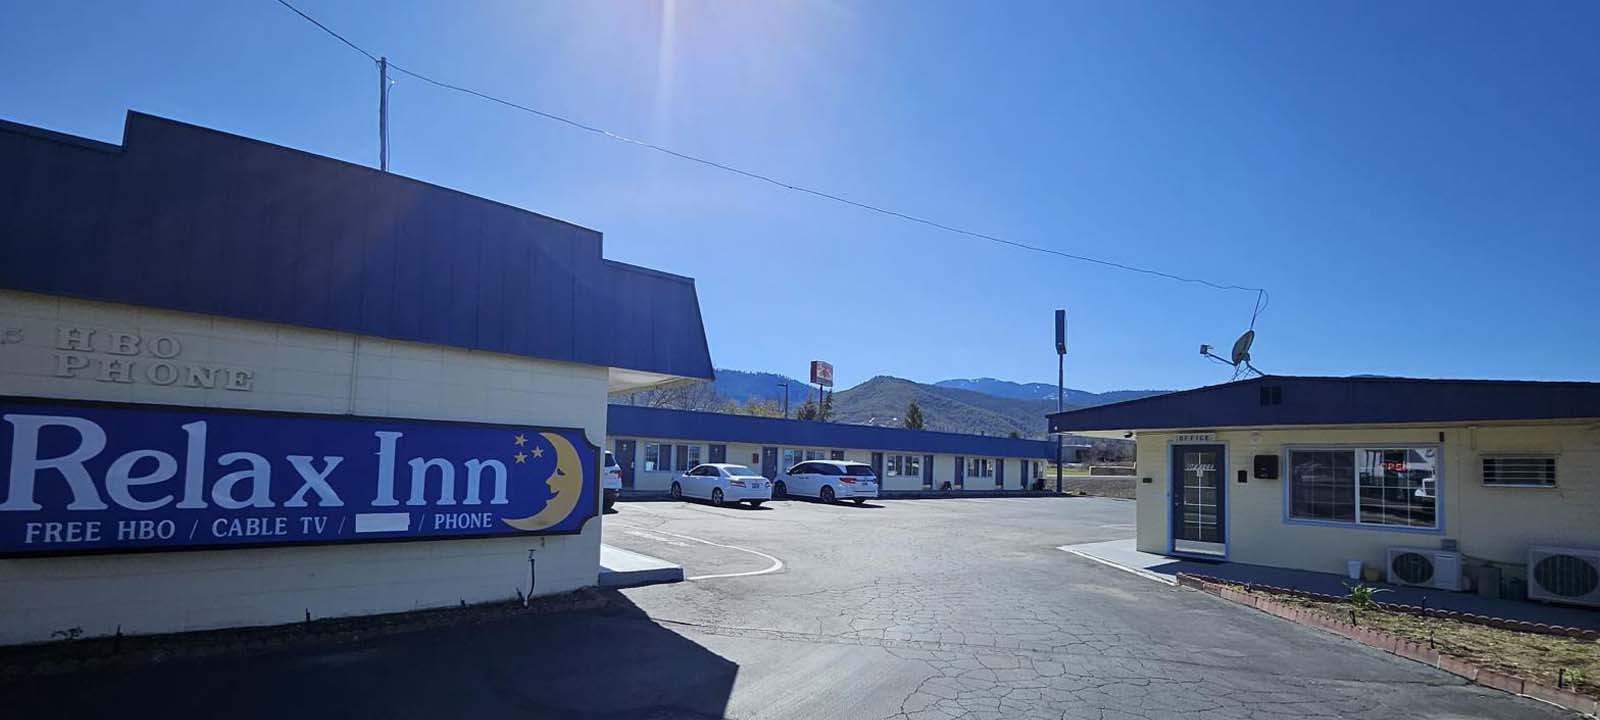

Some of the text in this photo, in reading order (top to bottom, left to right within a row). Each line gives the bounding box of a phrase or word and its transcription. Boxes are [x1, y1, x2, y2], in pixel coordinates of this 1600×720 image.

[56, 326, 181, 359] HBO
[54, 354, 254, 391] PHONE
[0, 414, 509, 511] Relax Inn
[24, 521, 101, 544] FREE
[117, 519, 175, 541] HBO
[212, 517, 288, 538] CABLE
[300, 516, 327, 534] TV
[434, 512, 493, 530] PHONE
